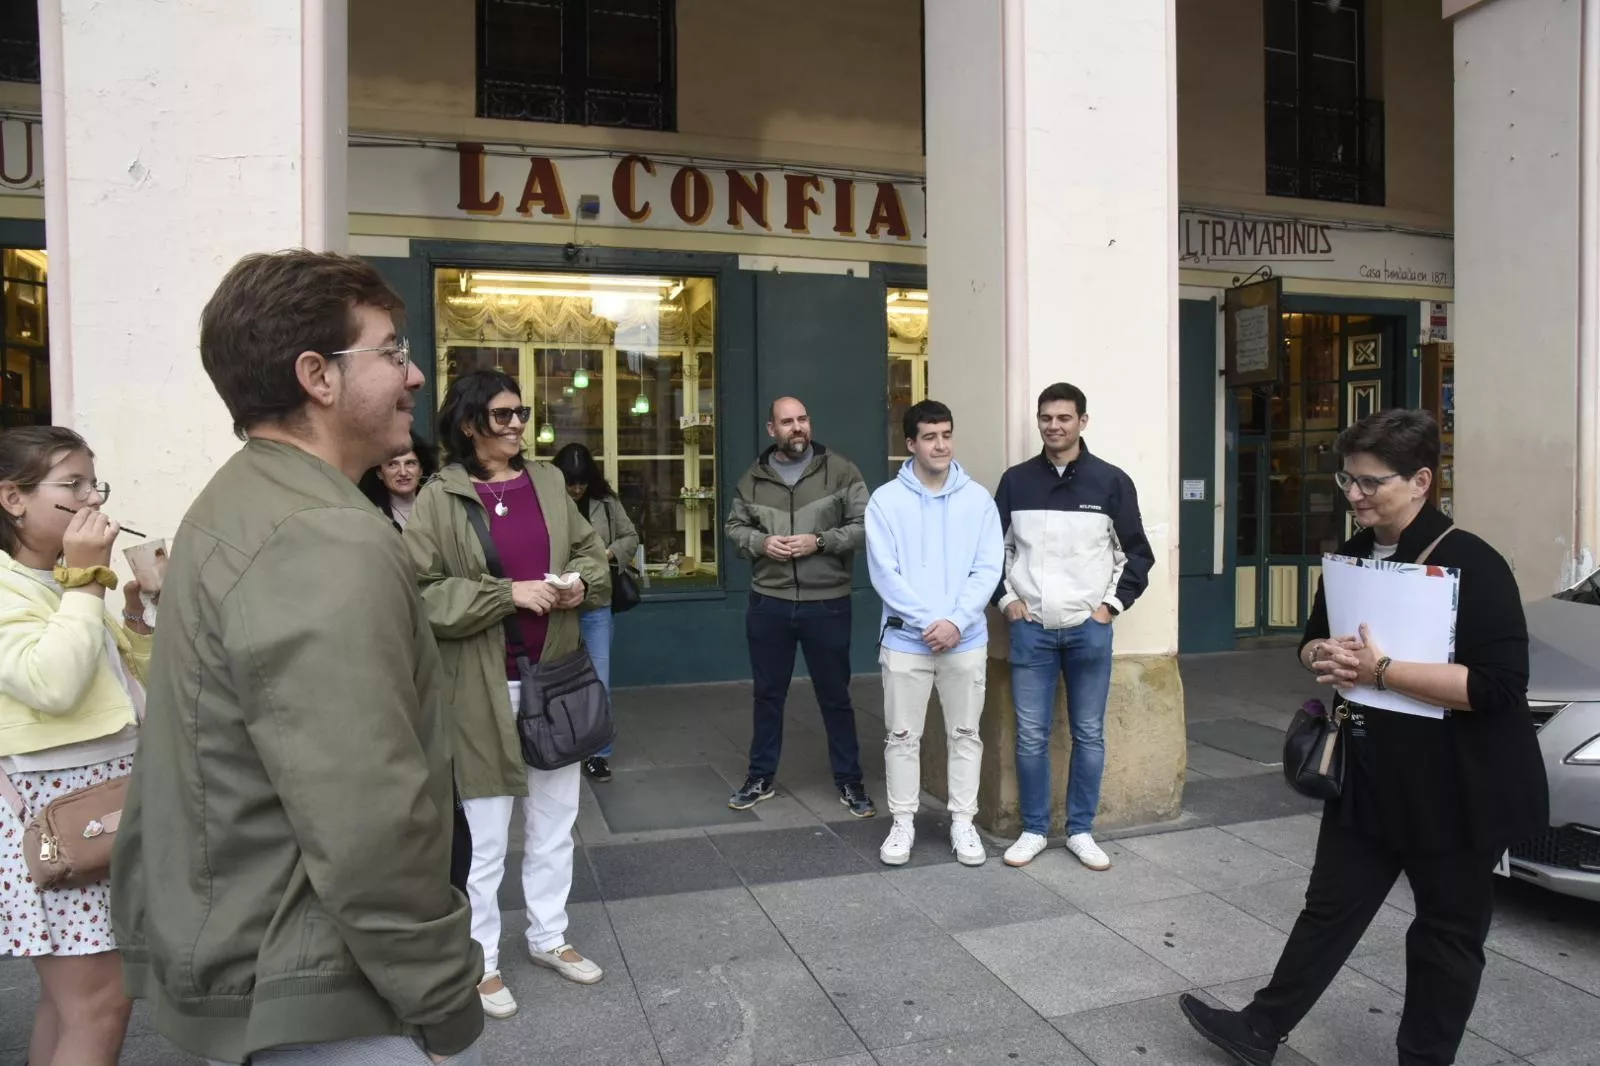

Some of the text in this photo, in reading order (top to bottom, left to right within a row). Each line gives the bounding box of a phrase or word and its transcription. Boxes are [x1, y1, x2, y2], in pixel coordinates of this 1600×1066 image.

[456, 142, 927, 241] LA CONFIA
[1178, 211, 1332, 256] LTRAMARINOS
[1359, 264, 1381, 279] Casa
